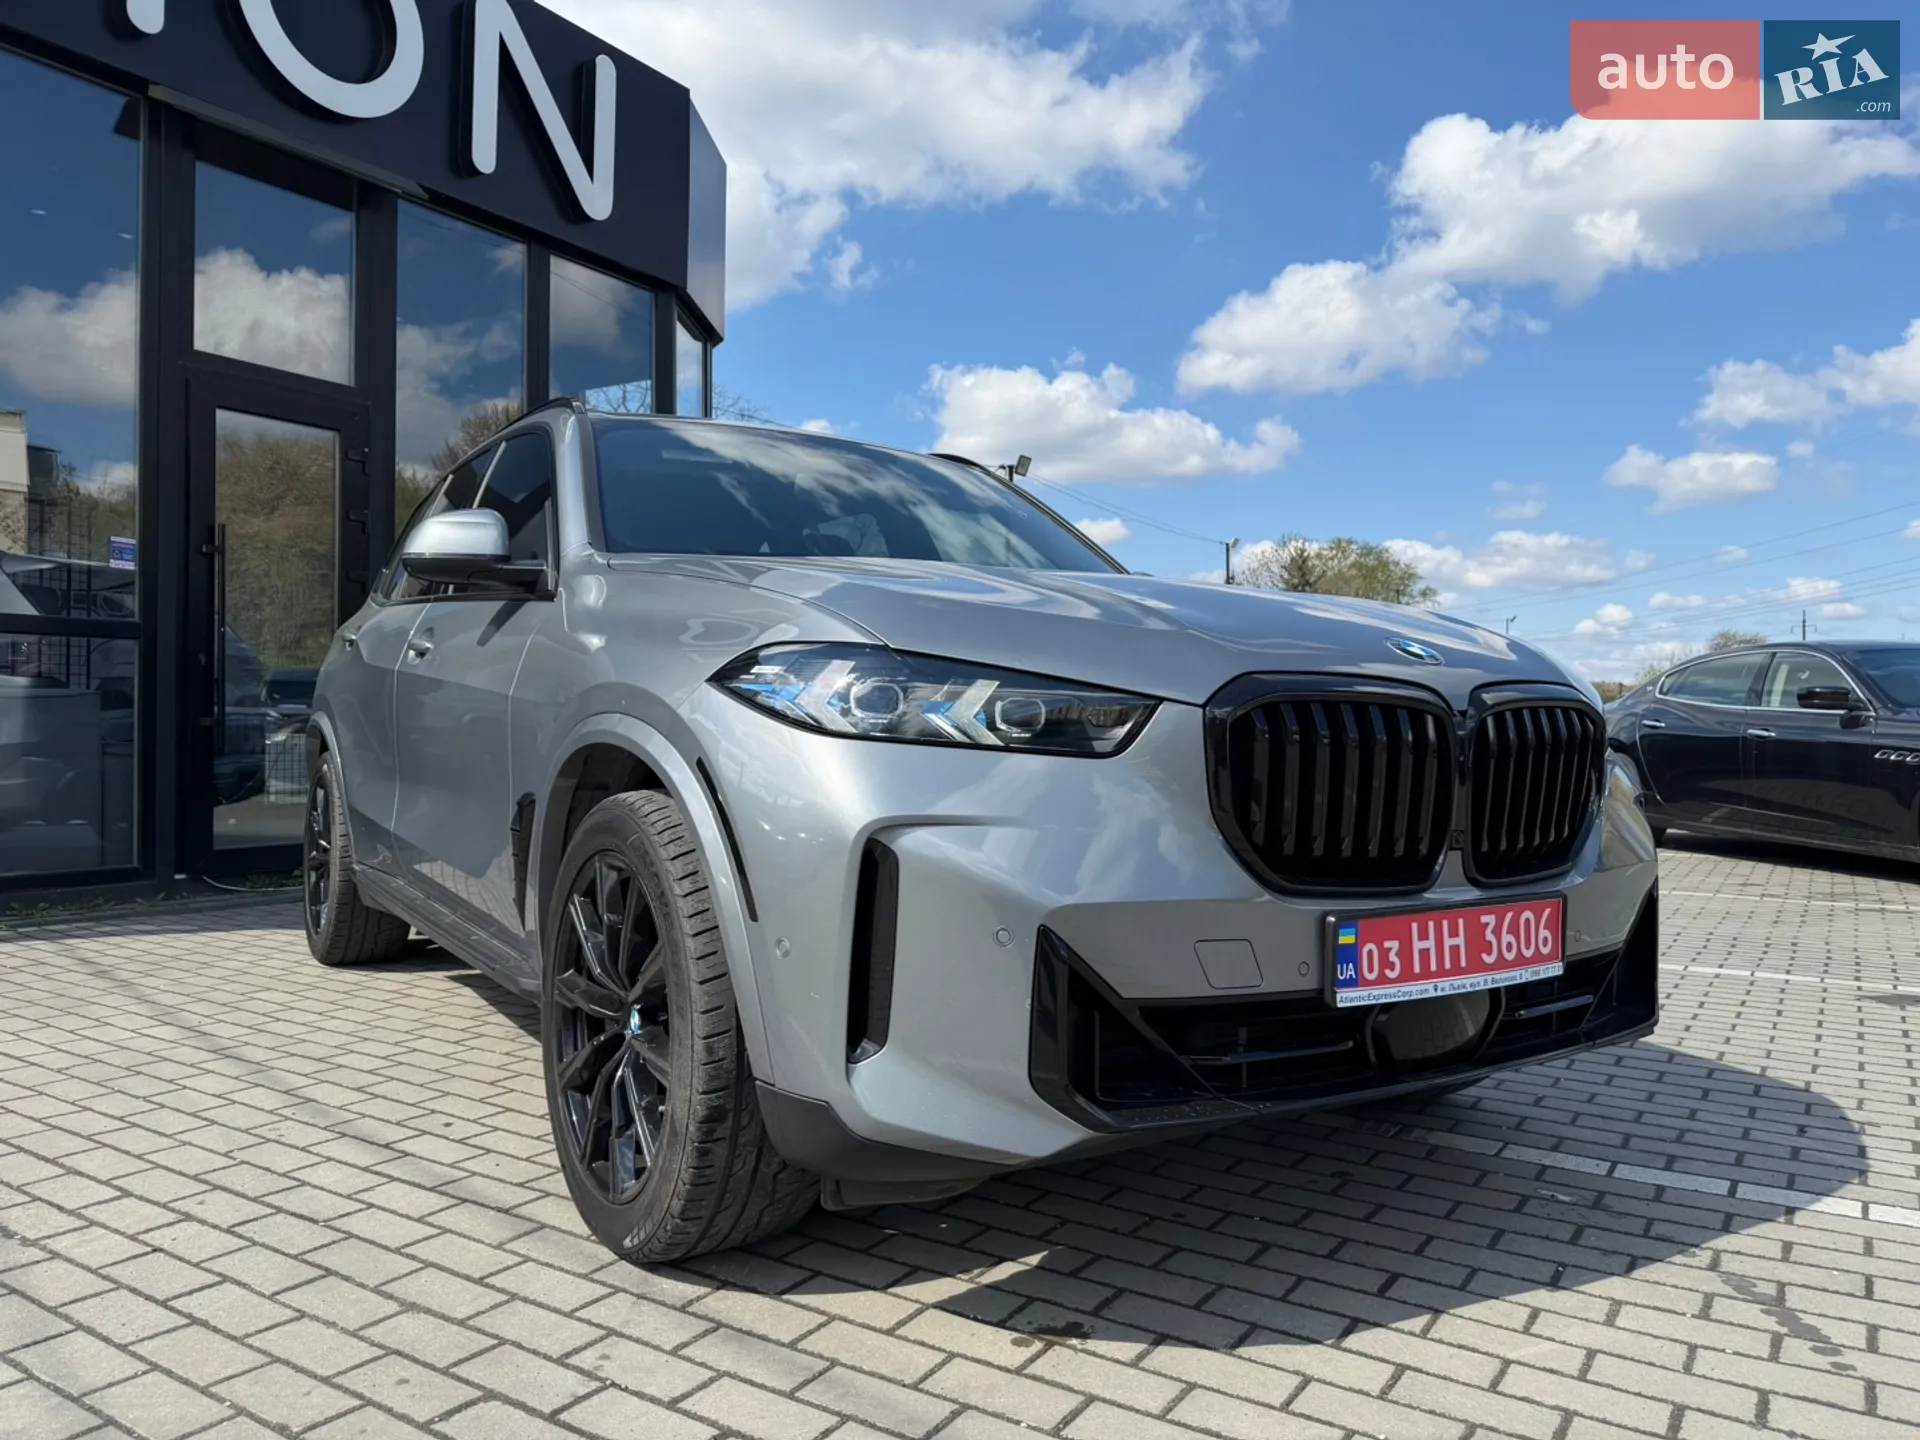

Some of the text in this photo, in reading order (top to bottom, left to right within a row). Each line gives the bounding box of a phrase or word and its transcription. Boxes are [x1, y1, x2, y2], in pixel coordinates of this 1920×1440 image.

[1361, 907, 1552, 981] 03 HH 3606
[1337, 963, 1356, 980] UA
[1338, 987, 1430, 1005] AtlanticExpressCorp.com
